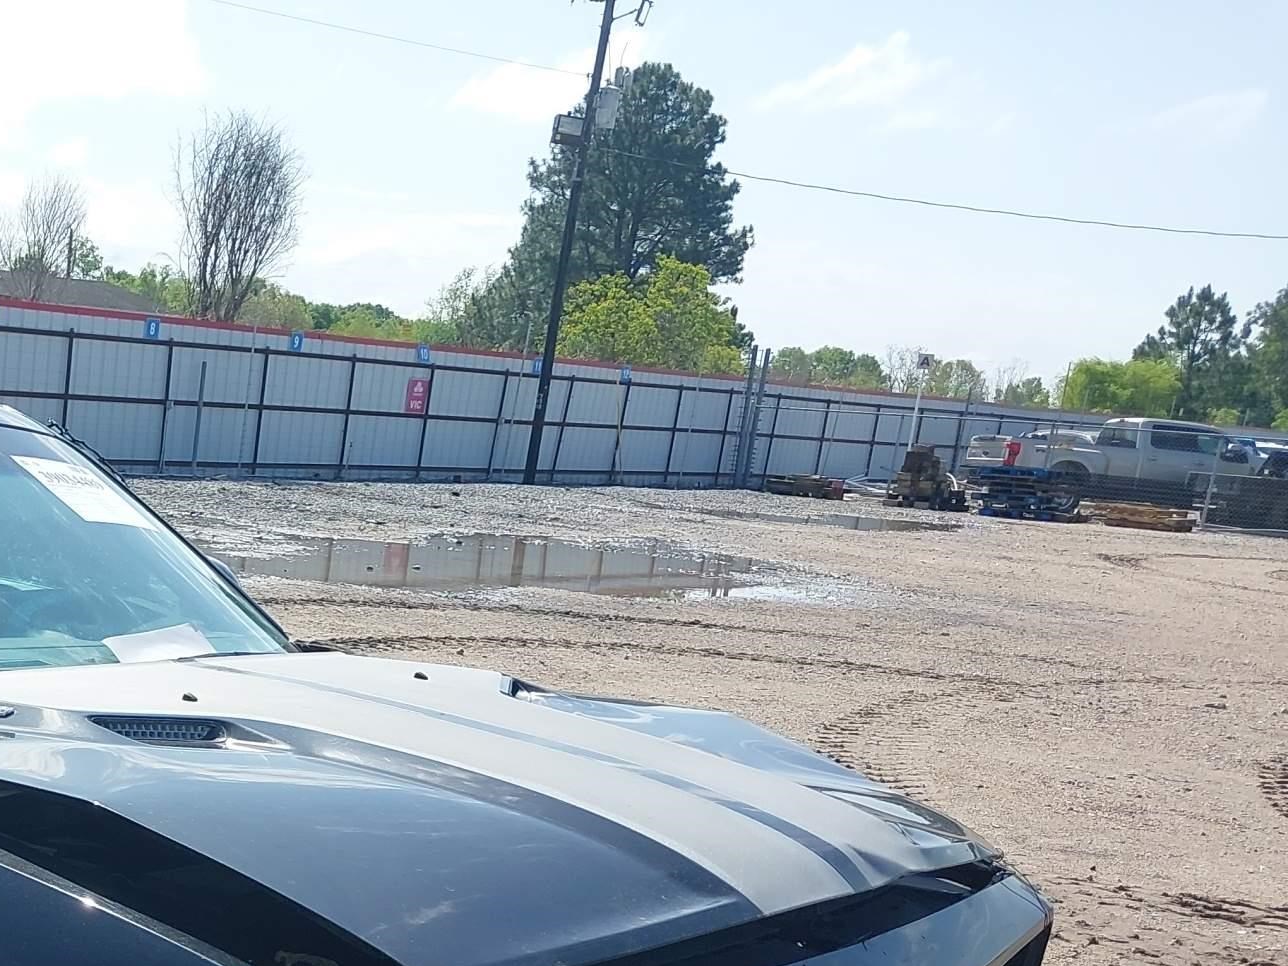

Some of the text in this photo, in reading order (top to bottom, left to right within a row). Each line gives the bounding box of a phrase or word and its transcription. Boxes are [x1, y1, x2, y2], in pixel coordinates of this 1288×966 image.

[149, 322, 156, 336] 8
[293, 335, 300, 348] 9
[920, 356, 930, 367] A
[410, 399, 423, 409] VIC
